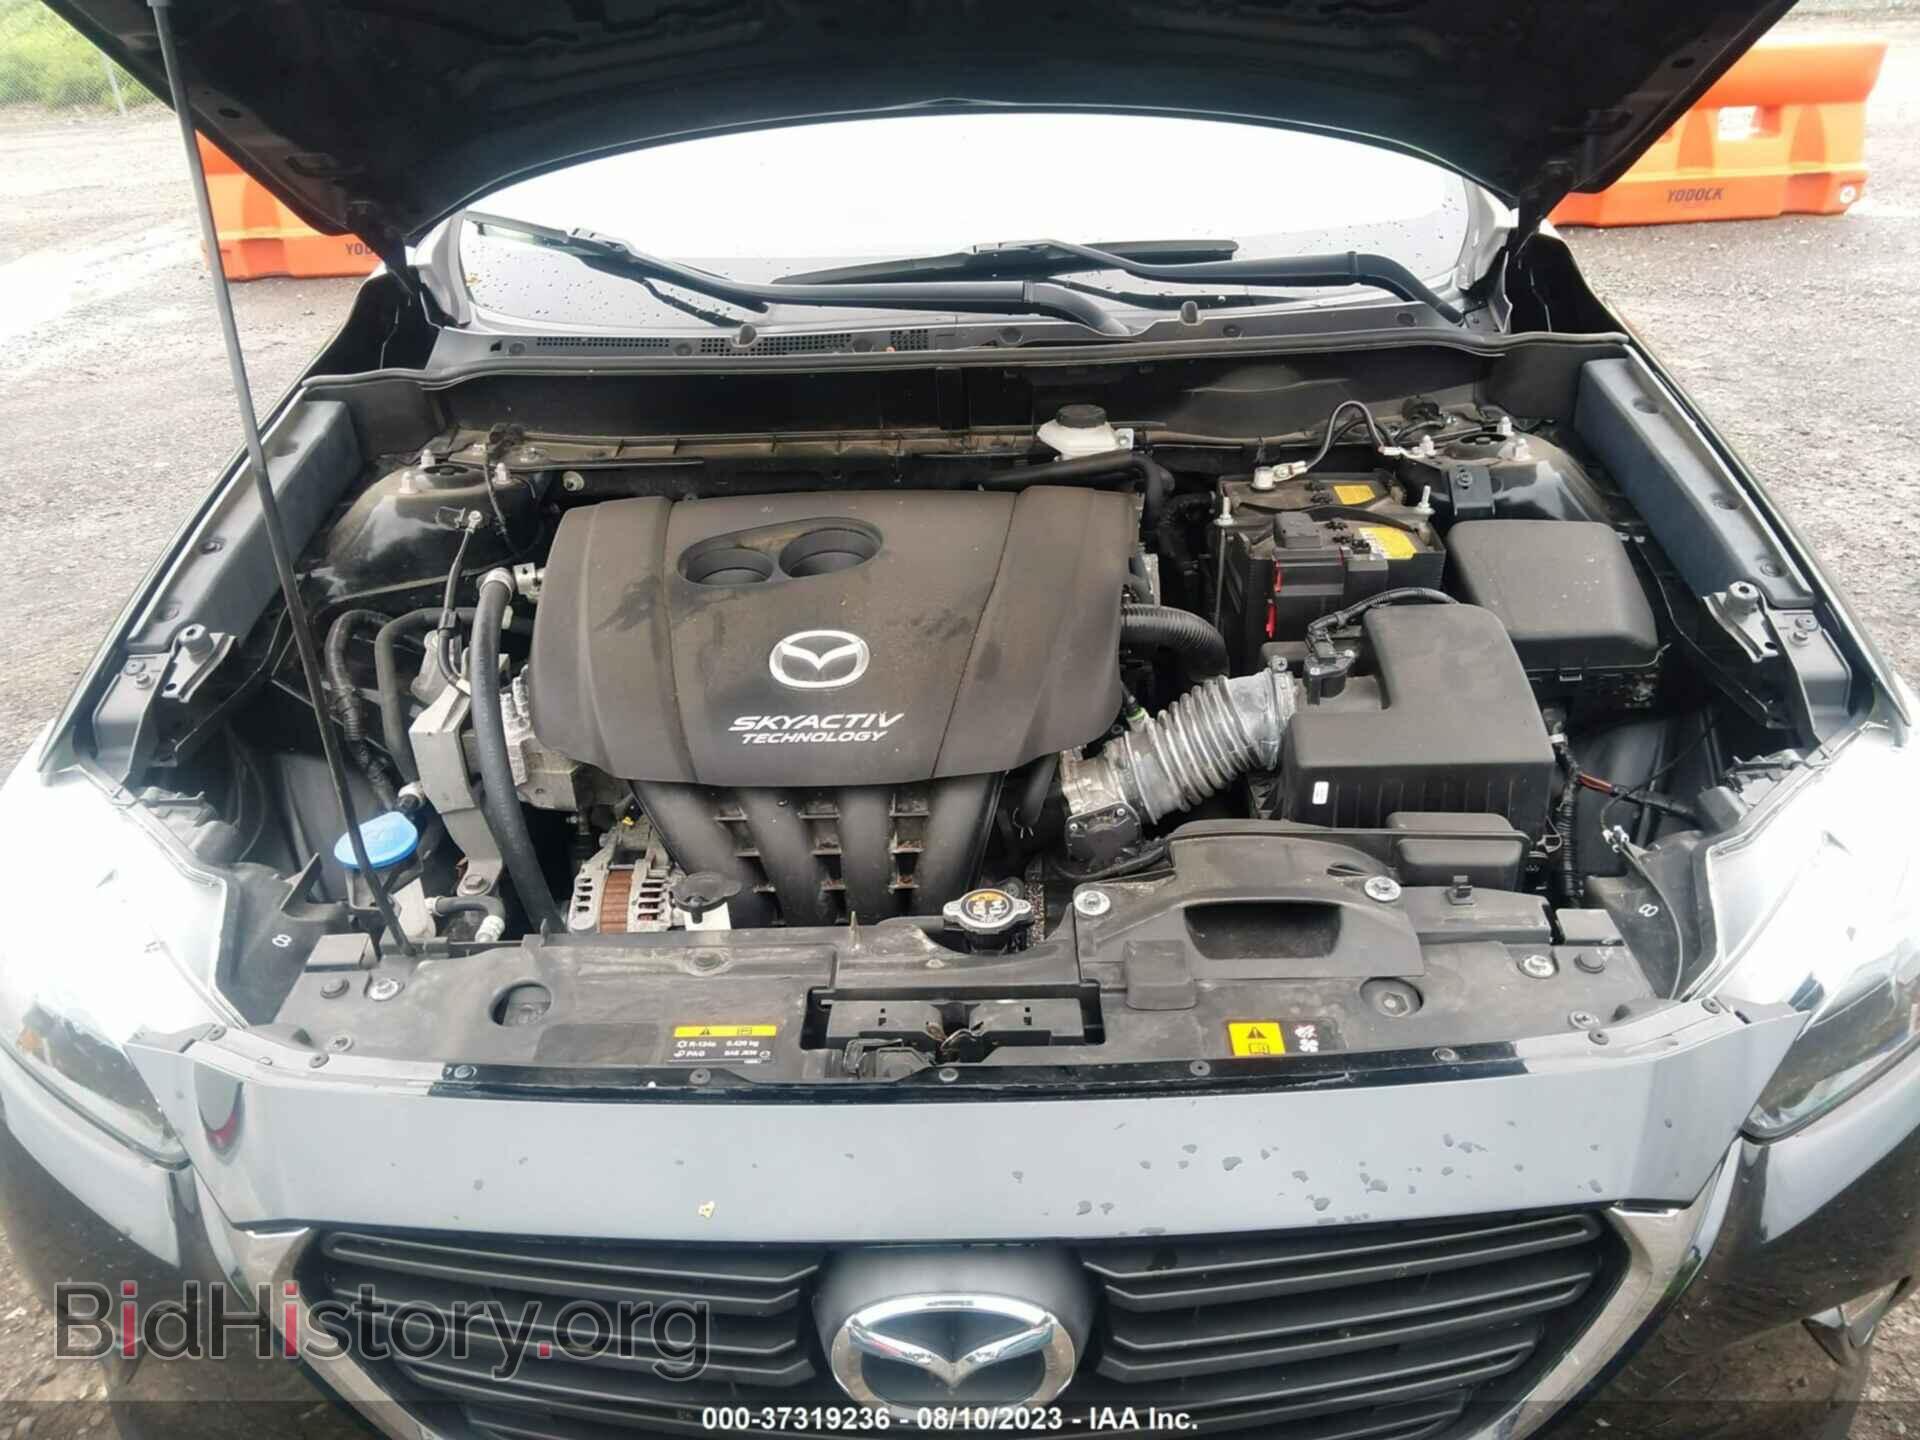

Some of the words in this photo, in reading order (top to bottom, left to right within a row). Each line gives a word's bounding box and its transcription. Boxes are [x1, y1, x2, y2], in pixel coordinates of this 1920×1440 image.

[1667, 187, 1724, 203] YODOCK
[728, 711, 904, 732] SKYACTIV
[742, 730, 888, 744] TECHNOLOGY
